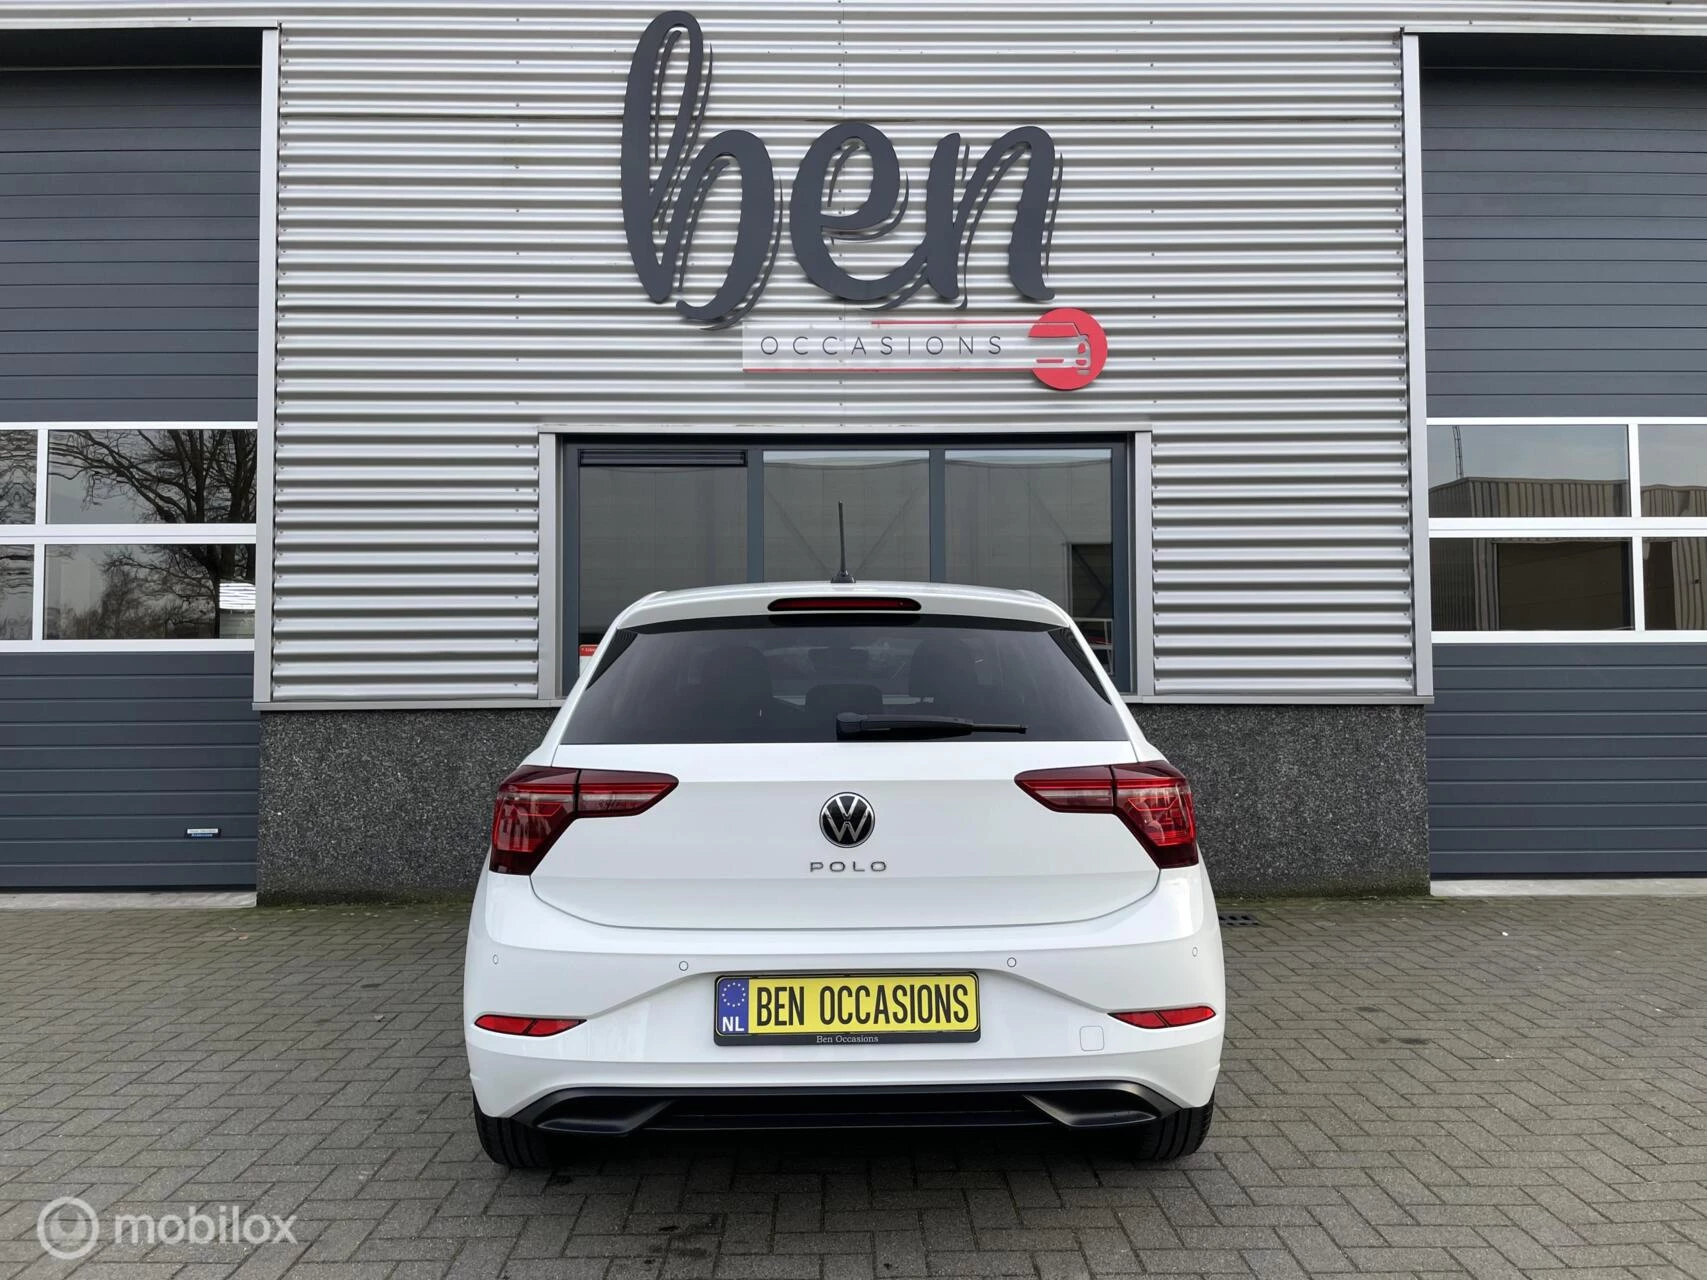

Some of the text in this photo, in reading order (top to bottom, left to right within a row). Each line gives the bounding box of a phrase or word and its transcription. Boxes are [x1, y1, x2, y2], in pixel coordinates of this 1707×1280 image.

[621, 10, 1060, 325] ben
[759, 336, 1002, 356] OCCASIONS
[809, 860, 887, 873] POLO
[755, 983, 970, 1027] BEN OCCASIONS
[721, 1016, 745, 1032] NL
[816, 1034, 879, 1043] Ben Occasions
